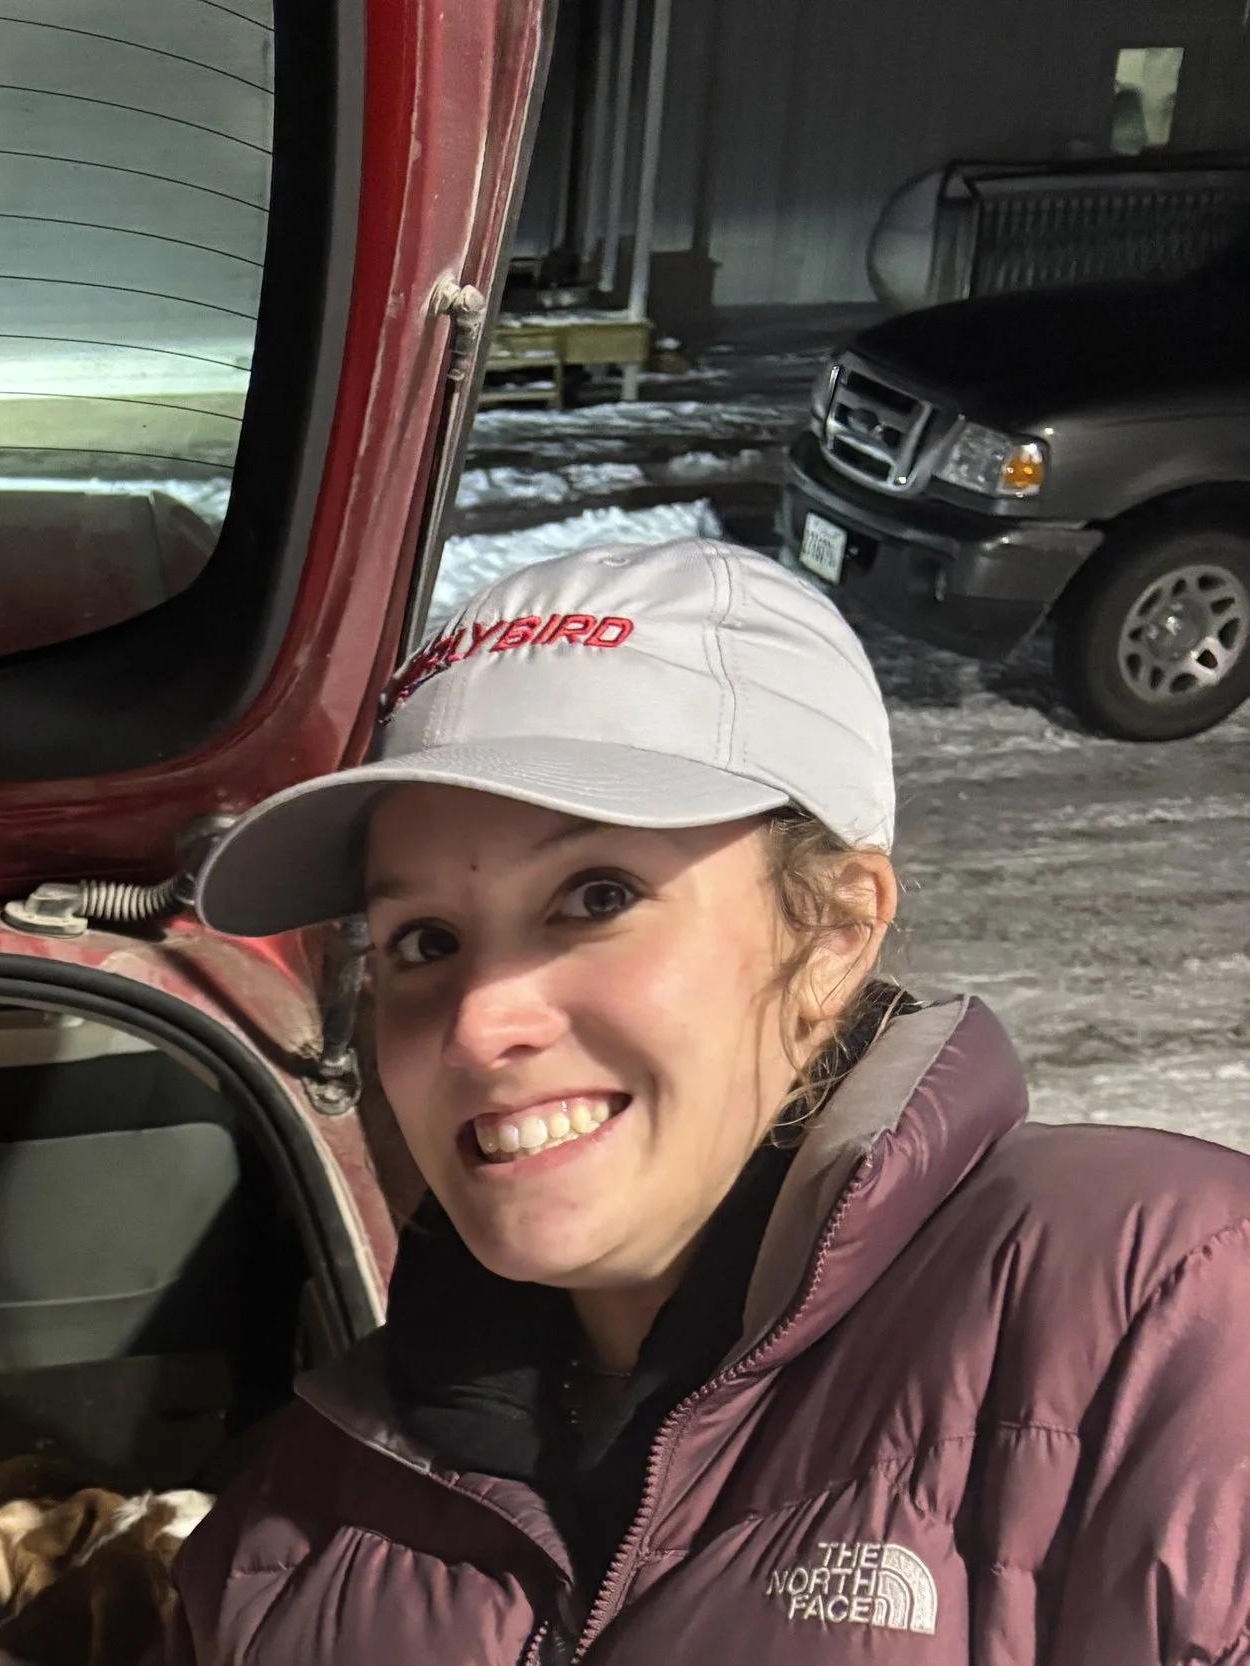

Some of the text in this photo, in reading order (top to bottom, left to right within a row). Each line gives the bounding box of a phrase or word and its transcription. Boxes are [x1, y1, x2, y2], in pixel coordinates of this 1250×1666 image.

[818, 1541, 881, 1568] THE
[765, 1567, 877, 1597] NORTH
[787, 1594, 874, 1623] FACE
